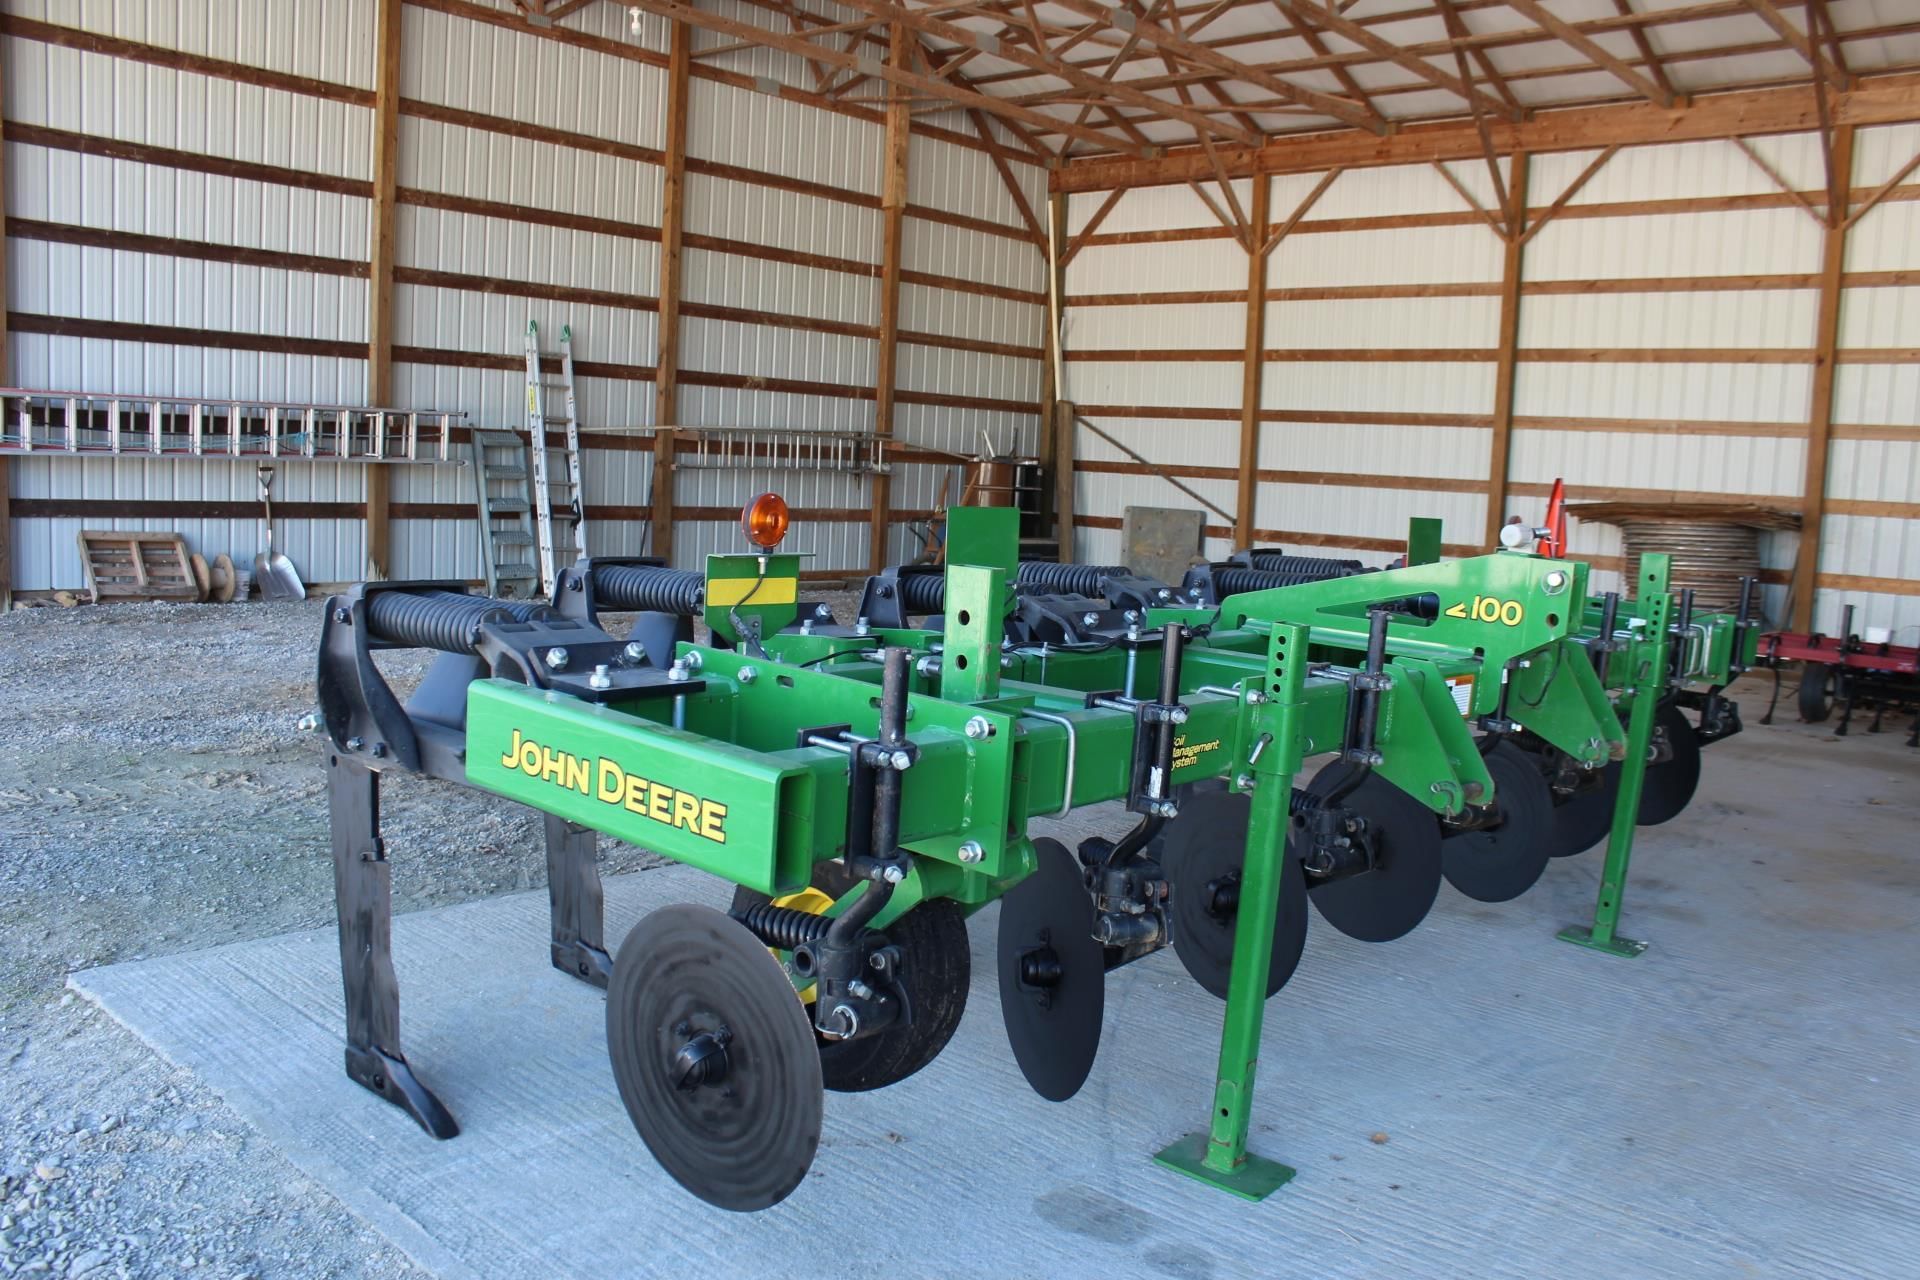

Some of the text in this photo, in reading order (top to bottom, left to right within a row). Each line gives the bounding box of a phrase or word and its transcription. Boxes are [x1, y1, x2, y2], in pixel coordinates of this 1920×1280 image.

[1173, 734, 1186, 747] oil
[1170, 756, 1197, 772] ystem
[501, 728, 728, 844] JOHN DEERE
